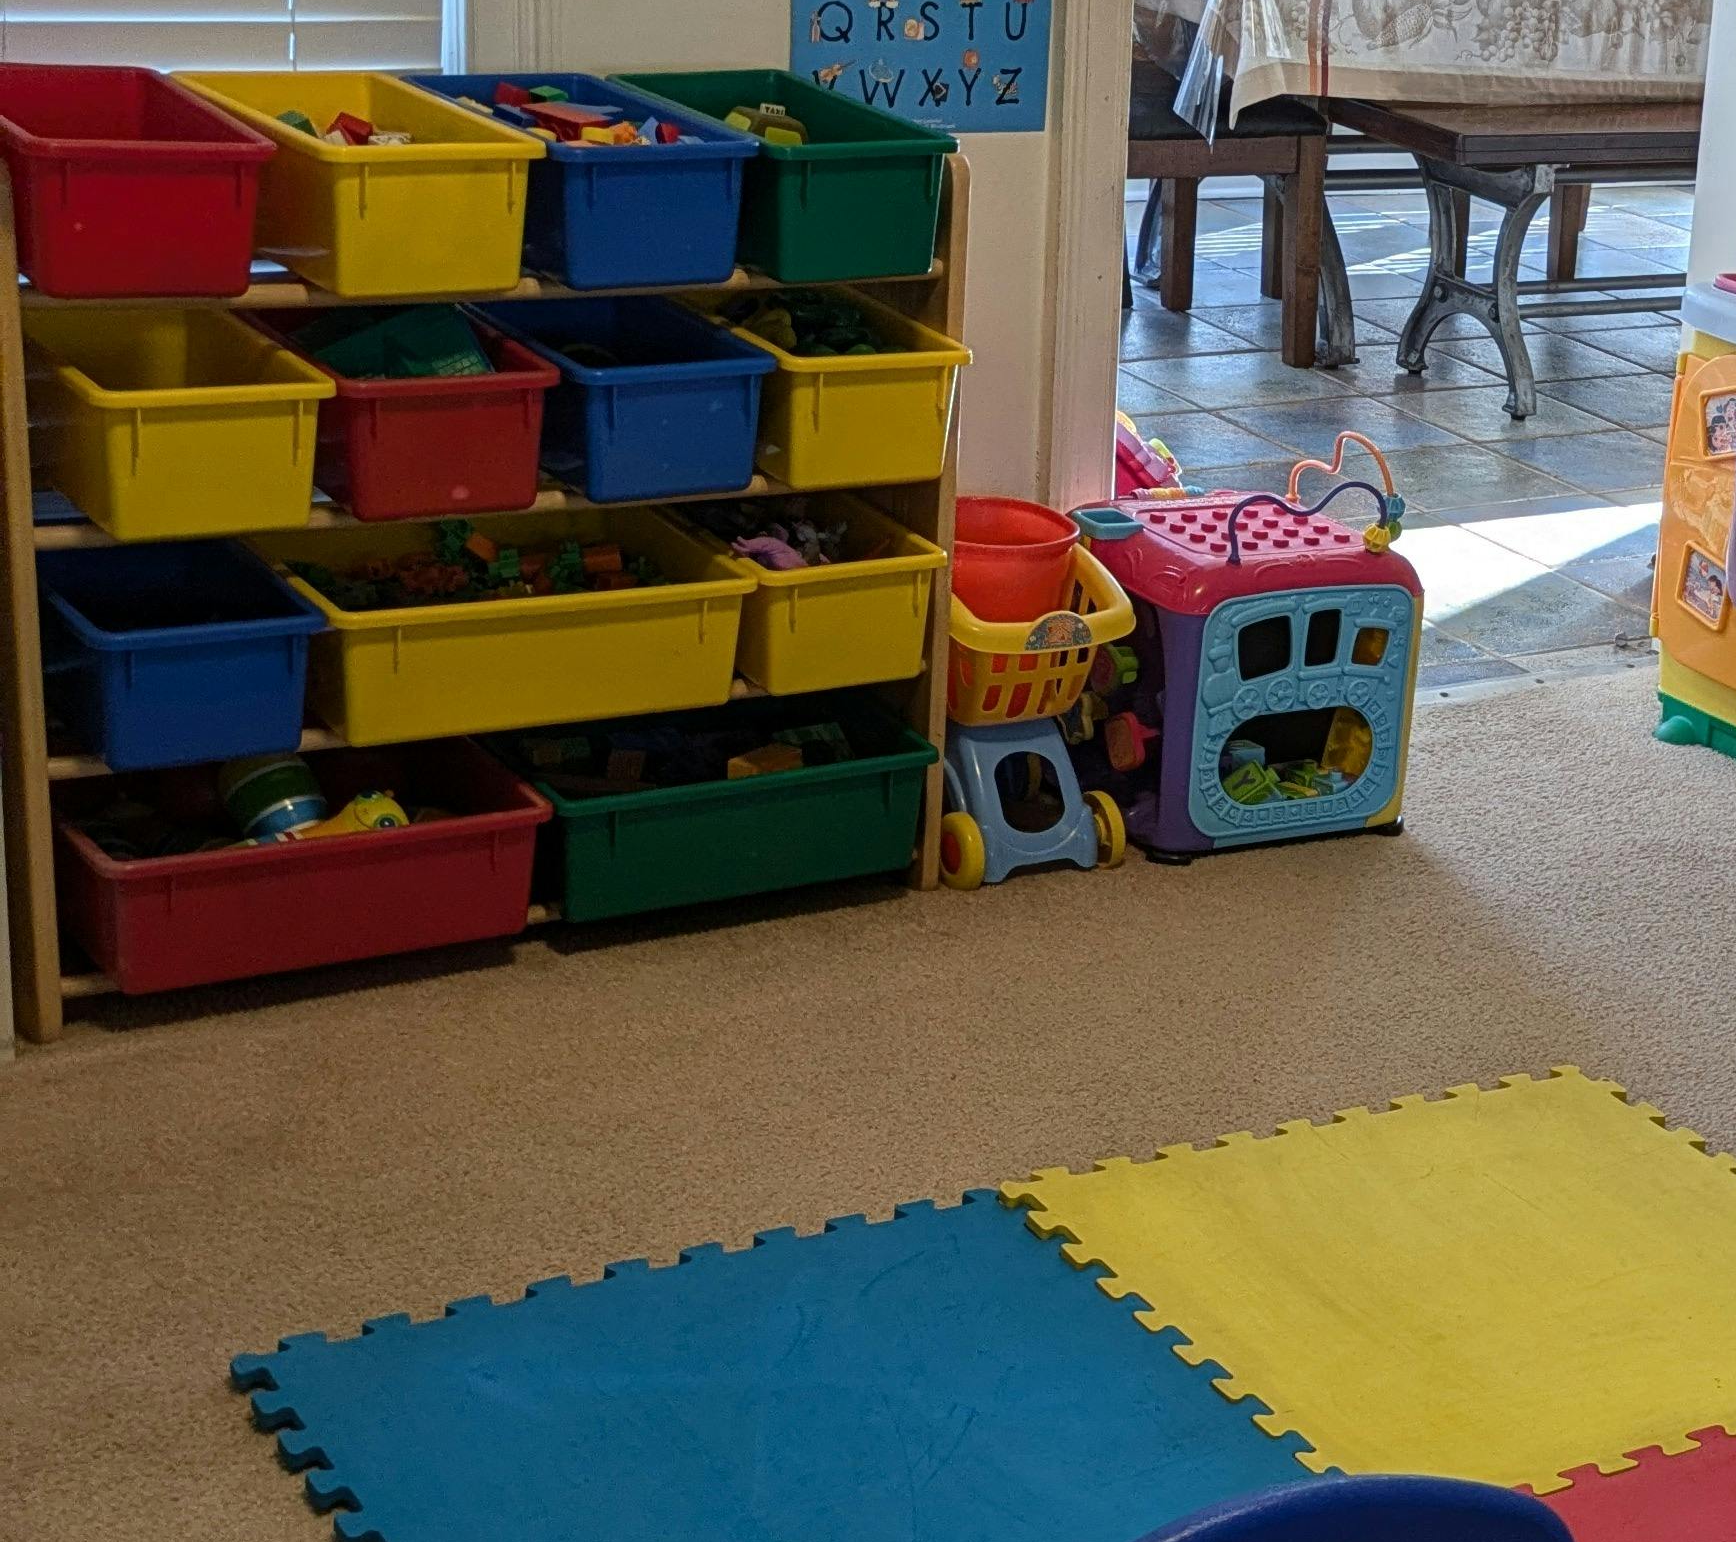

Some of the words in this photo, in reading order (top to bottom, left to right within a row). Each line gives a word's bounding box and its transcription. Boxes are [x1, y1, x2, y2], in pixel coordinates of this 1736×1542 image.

[817, 0, 854, 44] Q
[876, 1, 895, 41] R
[920, 1, 940, 41] S
[961, 2, 983, 41] T
[1005, 1, 1027, 41] U
[859, 68, 905, 108] W
[919, 68, 949, 107] X
[958, 68, 982, 107] Y
[995, 68, 1022, 106] Z
